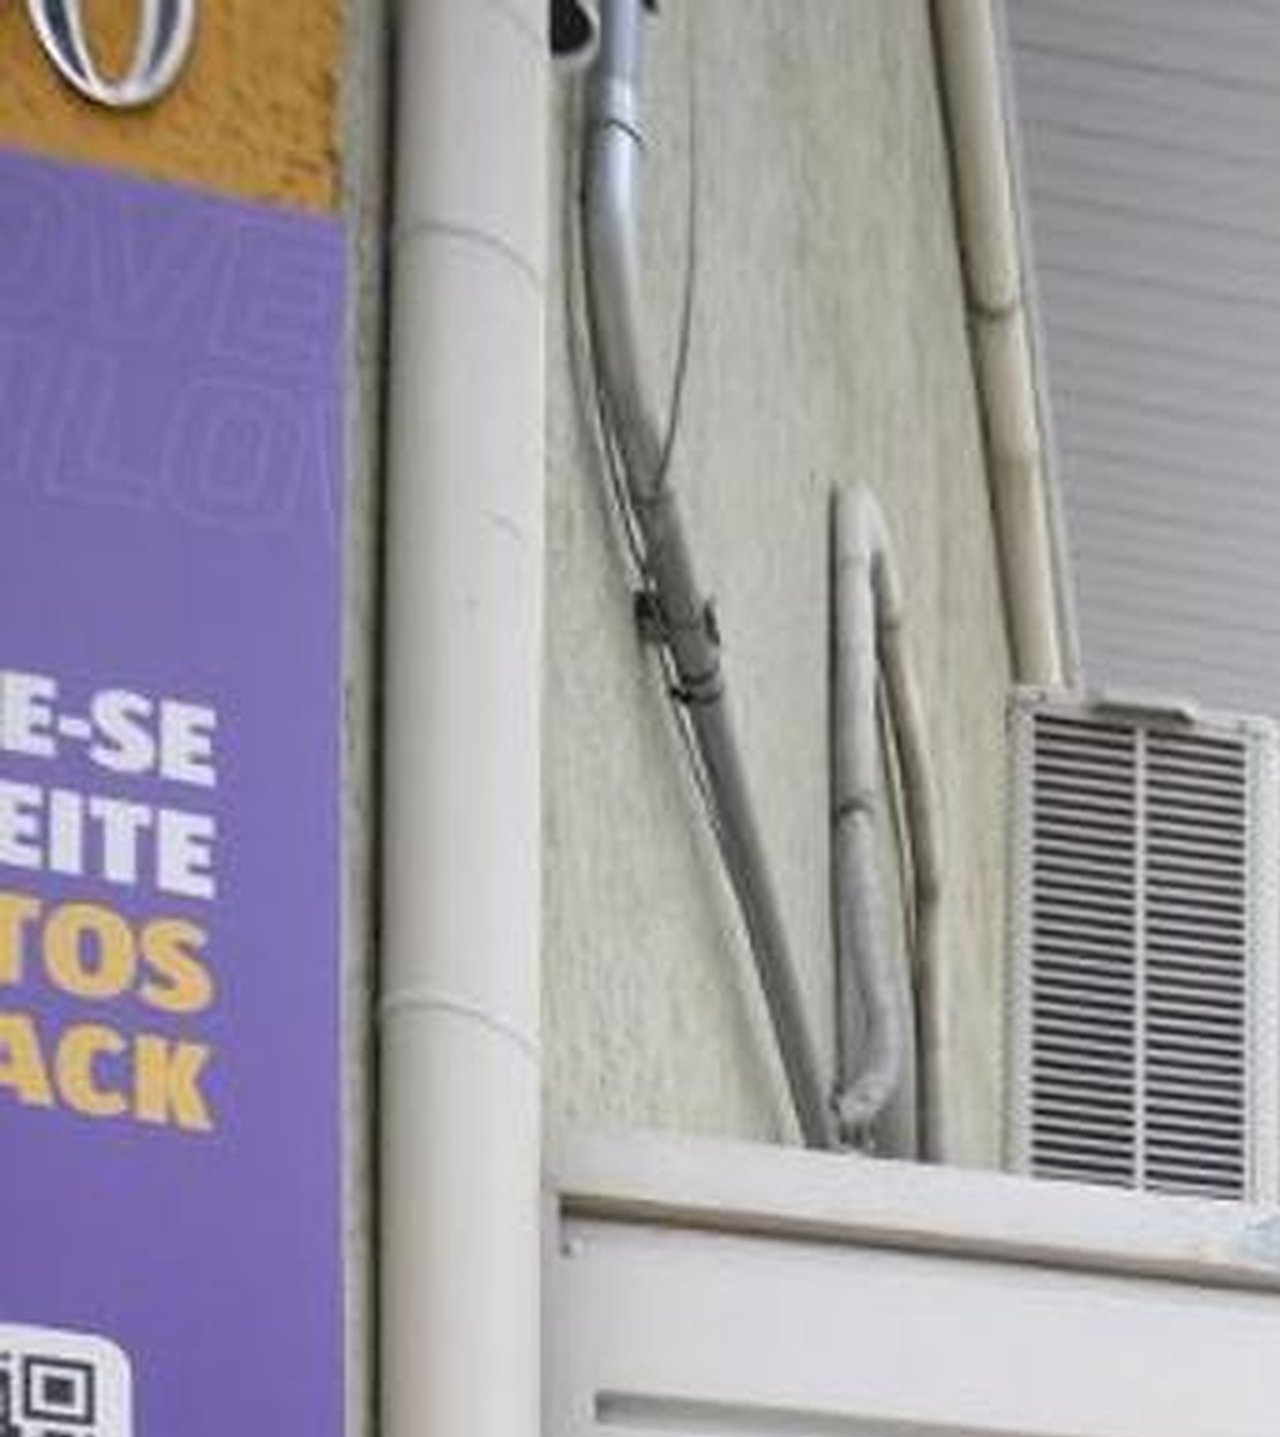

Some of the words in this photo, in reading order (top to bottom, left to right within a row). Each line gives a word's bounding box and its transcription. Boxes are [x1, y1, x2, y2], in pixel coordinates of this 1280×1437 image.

[0, 669, 216, 788] E-SE
[0, 779, 216, 899] EITE
[0, 890, 213, 1013] TOS
[0, 1010, 212, 1133] ACK
